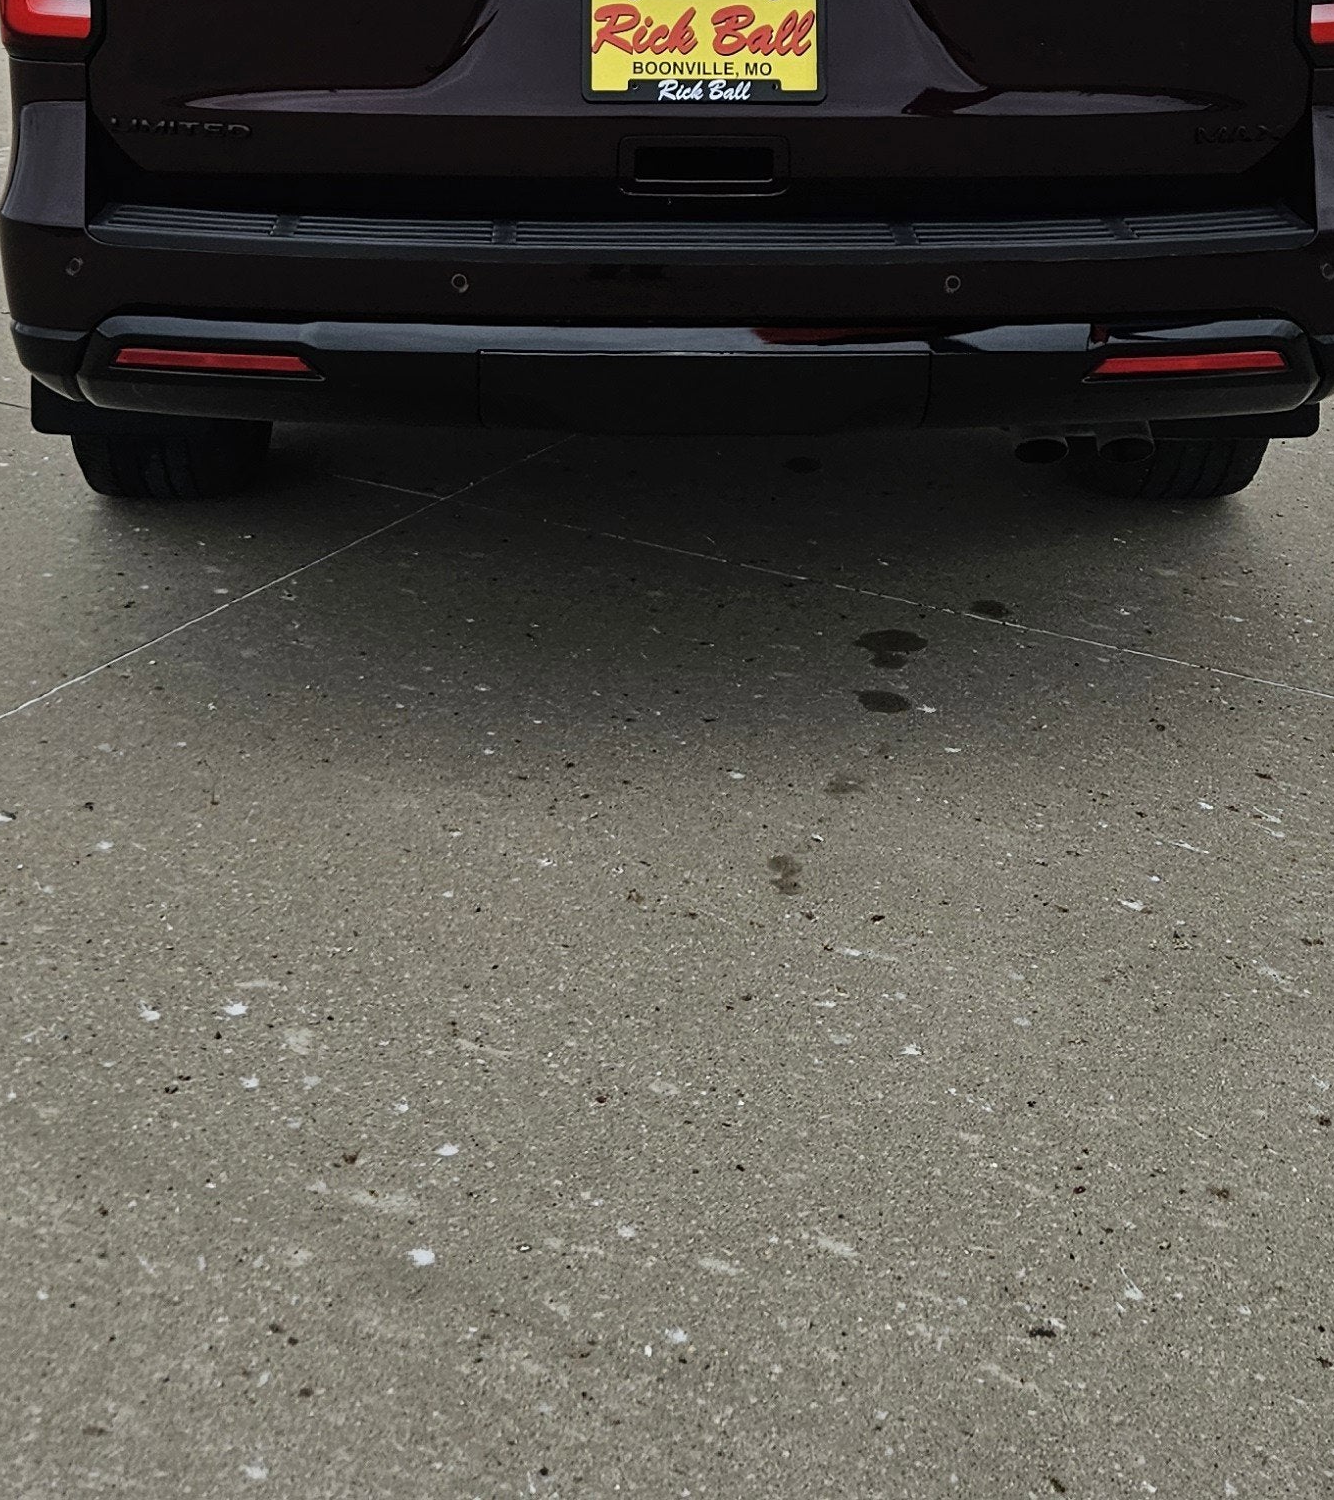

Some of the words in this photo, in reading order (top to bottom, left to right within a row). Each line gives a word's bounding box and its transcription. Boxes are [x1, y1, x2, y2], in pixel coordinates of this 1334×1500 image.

[591, 3, 699, 56] Rick
[711, 4, 815, 57] Ball
[632, 61, 740, 77] BOONVILLE,
[744, 62, 773, 76] MO
[657, 79, 704, 101] Rick
[708, 80, 752, 101] Ball
